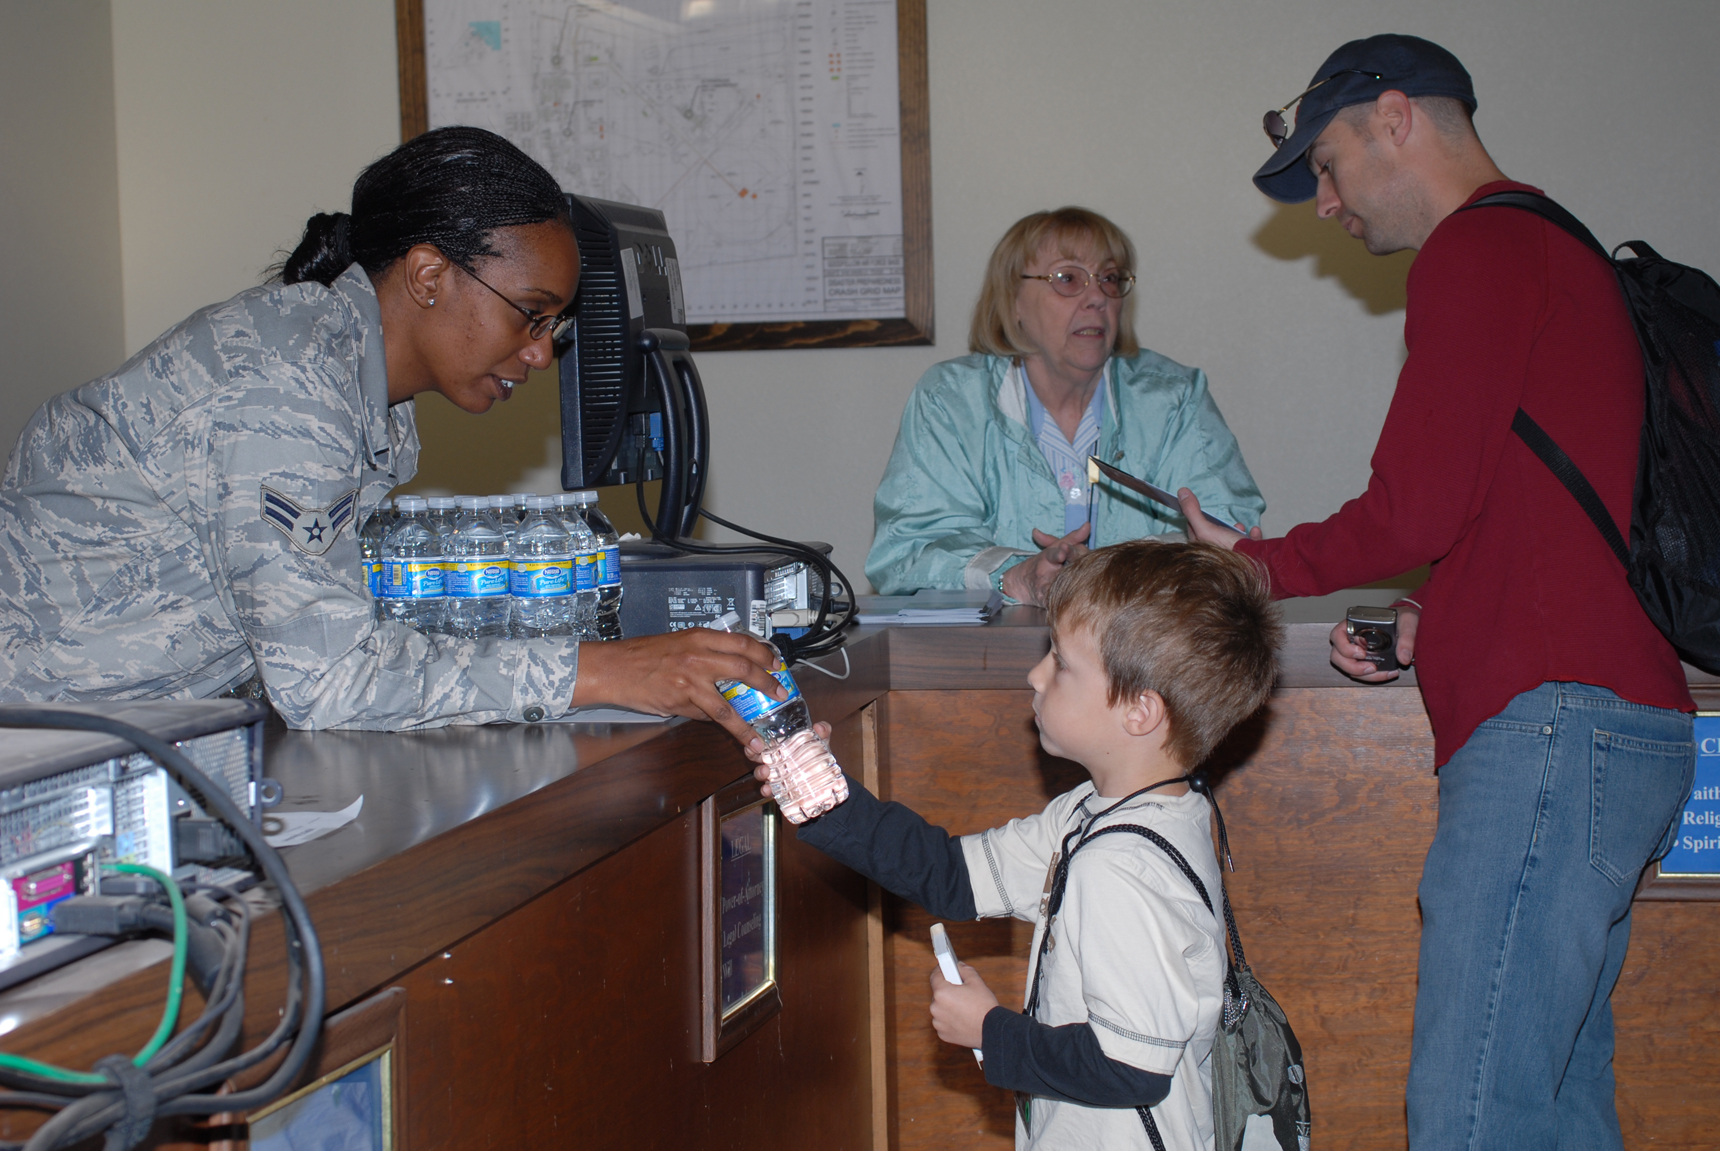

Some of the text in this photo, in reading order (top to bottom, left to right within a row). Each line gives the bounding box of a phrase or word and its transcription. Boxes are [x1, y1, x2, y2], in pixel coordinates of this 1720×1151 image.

[1694, 786, 1720, 801] aith
[731, 833, 751, 859] LEGAL
[723, 924, 737, 949] Legal
